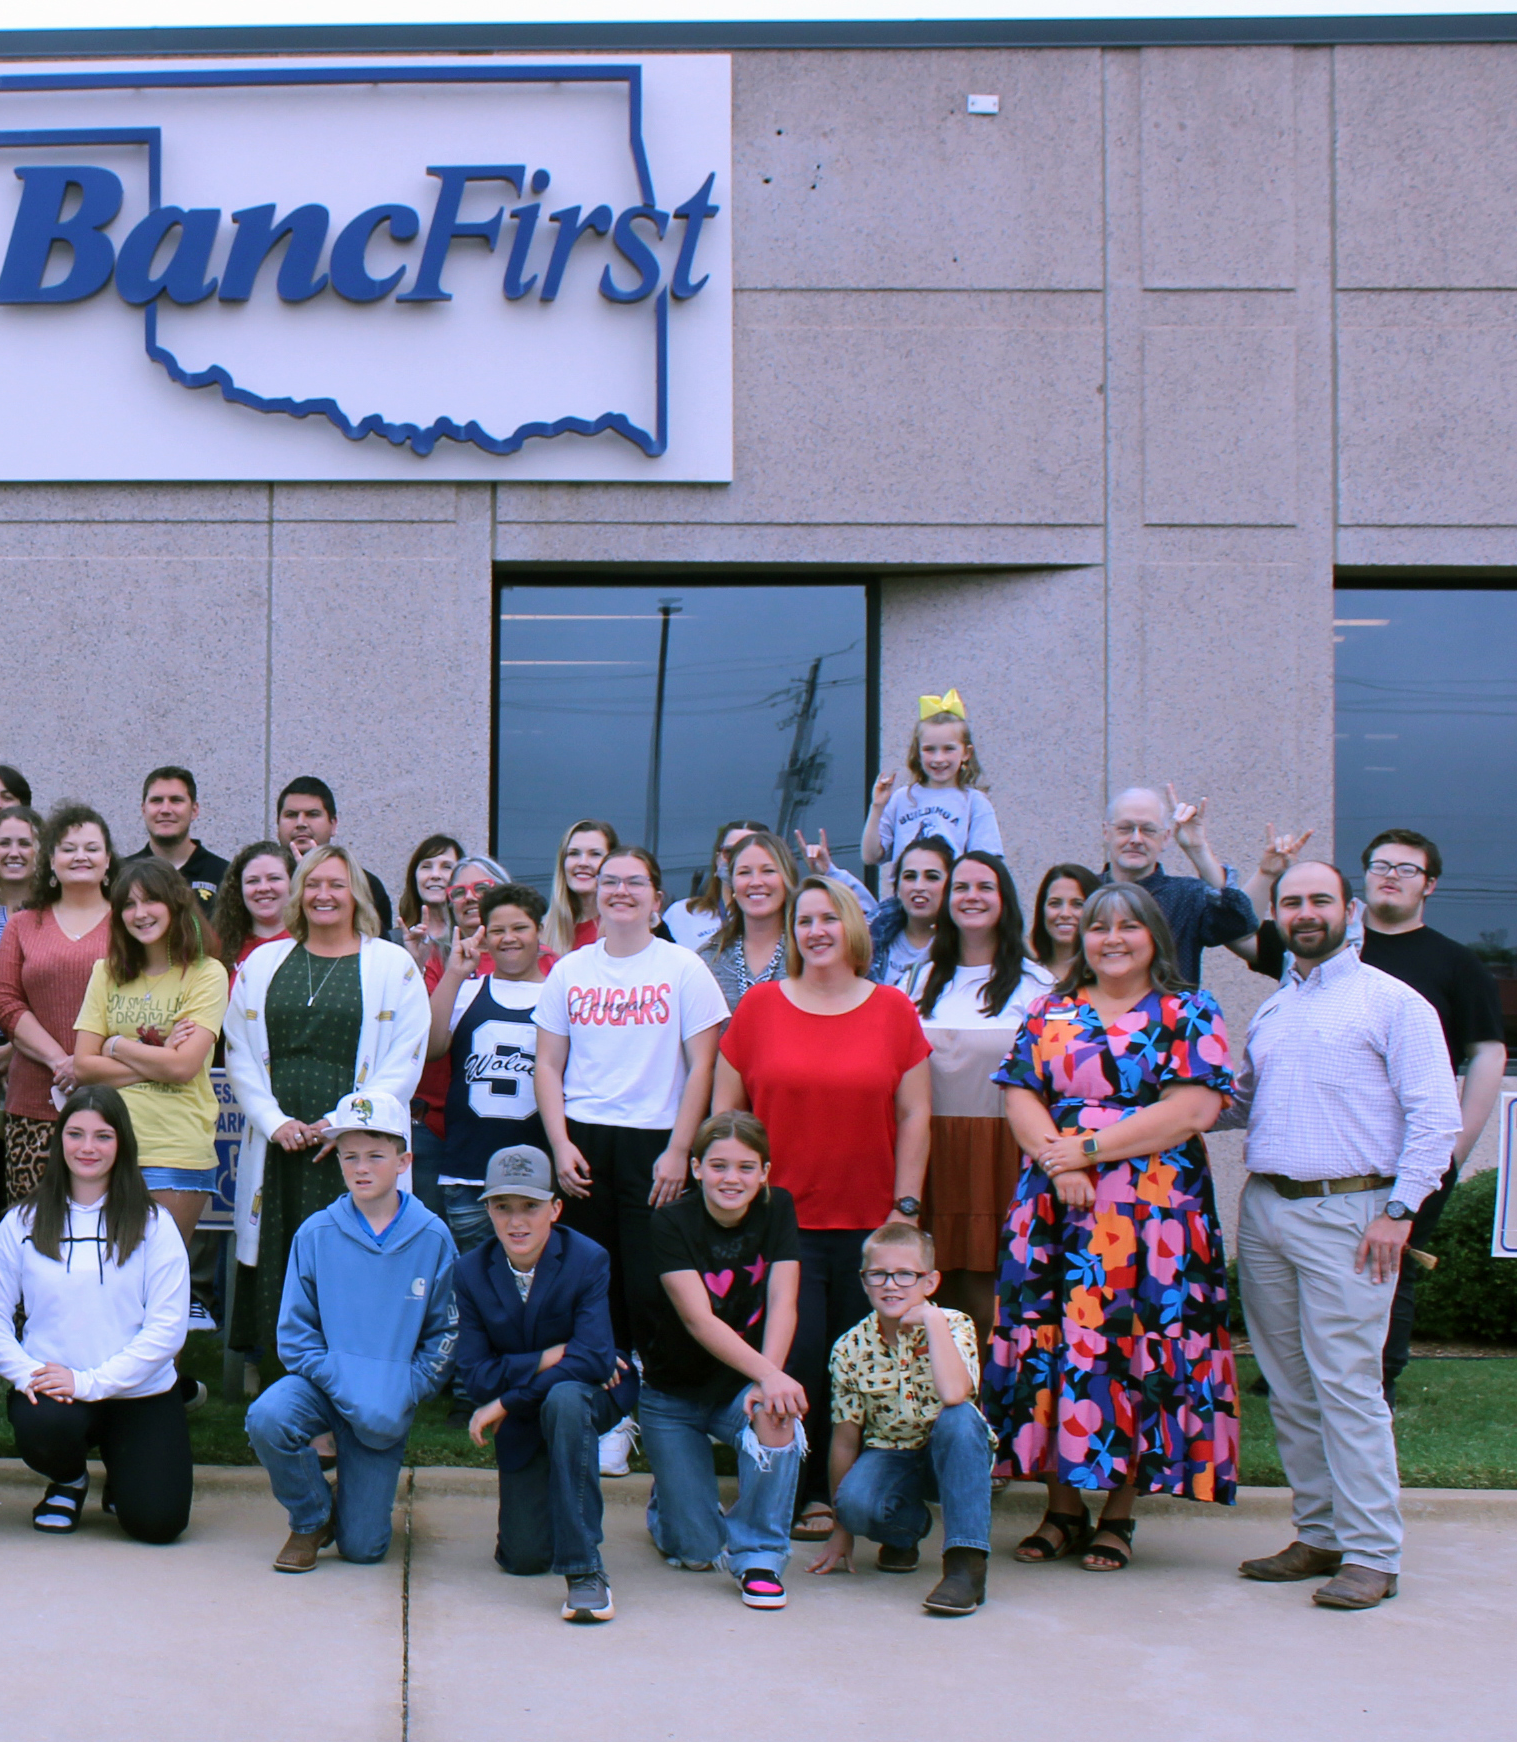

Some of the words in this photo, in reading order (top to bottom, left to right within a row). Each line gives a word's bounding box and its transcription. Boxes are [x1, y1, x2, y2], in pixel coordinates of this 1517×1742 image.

[107, 992, 126, 1014] YOU
[126, 997, 163, 1012] SMELL
[567, 983, 671, 1026] COUGARS
